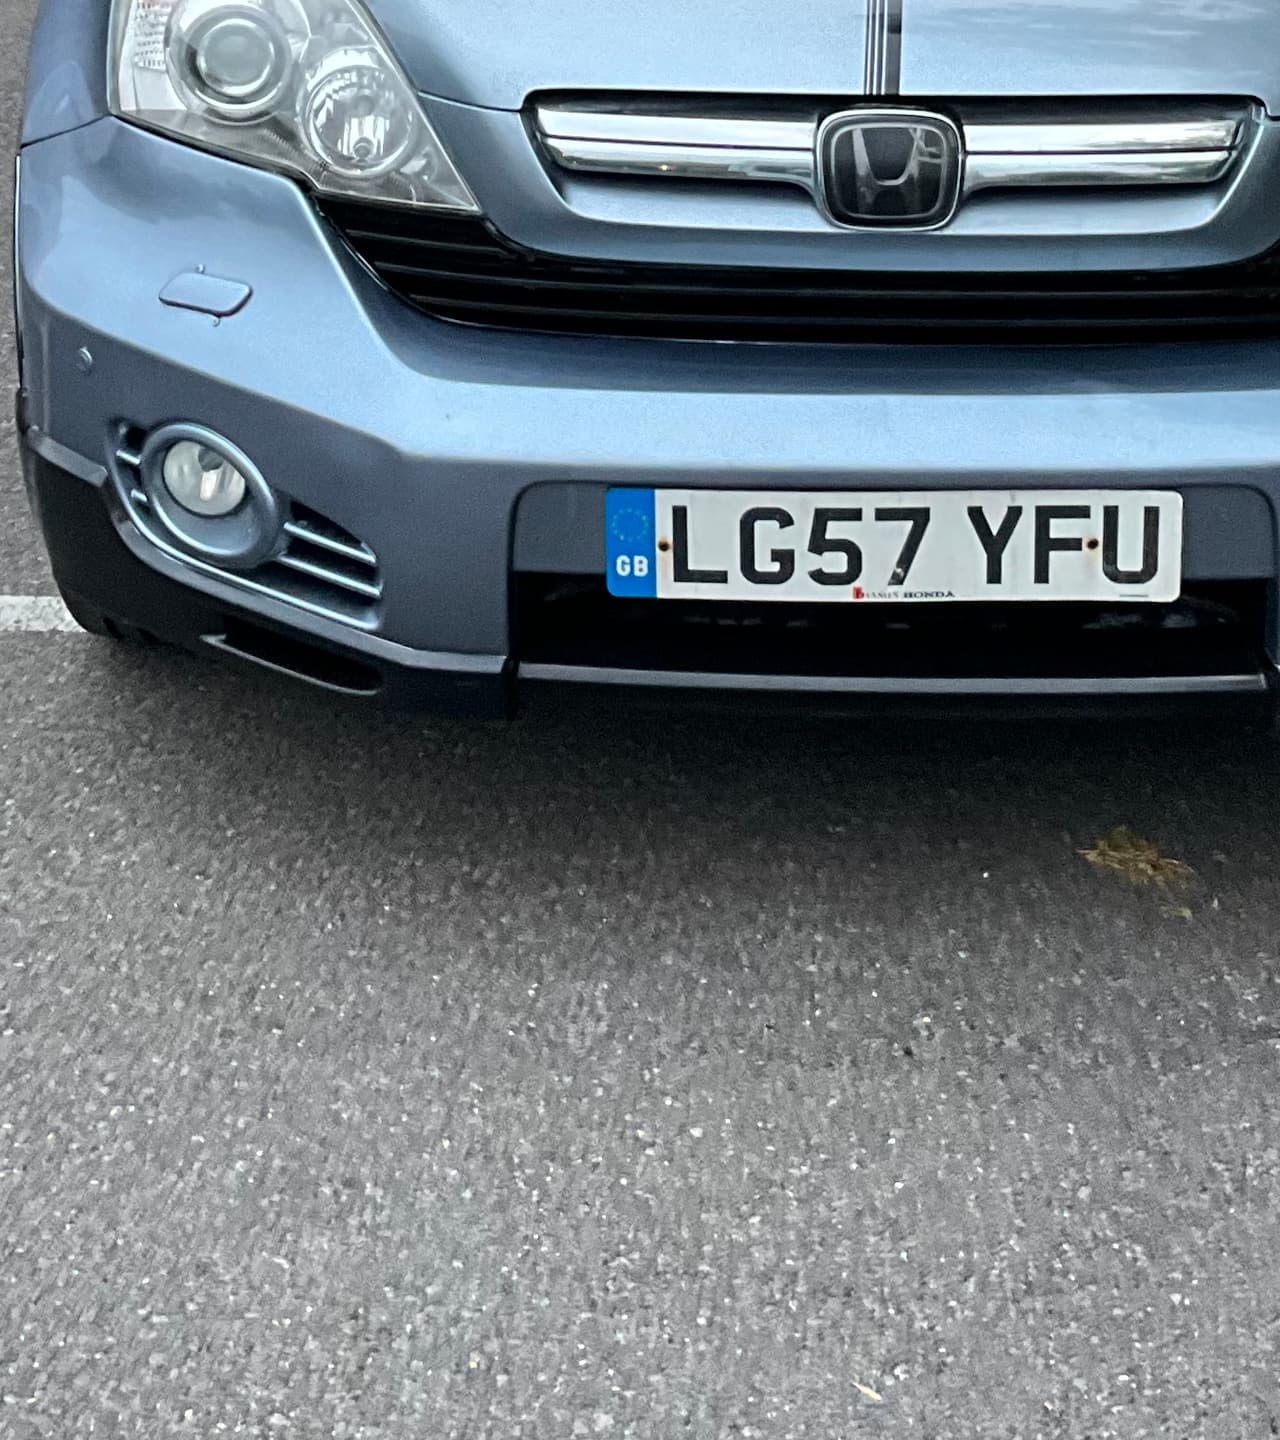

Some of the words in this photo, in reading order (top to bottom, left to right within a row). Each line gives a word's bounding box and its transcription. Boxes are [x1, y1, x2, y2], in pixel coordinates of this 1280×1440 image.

[616, 554, 649, 577] GB
[671, 504, 931, 586] LG57
[966, 504, 1161, 585] YFU
